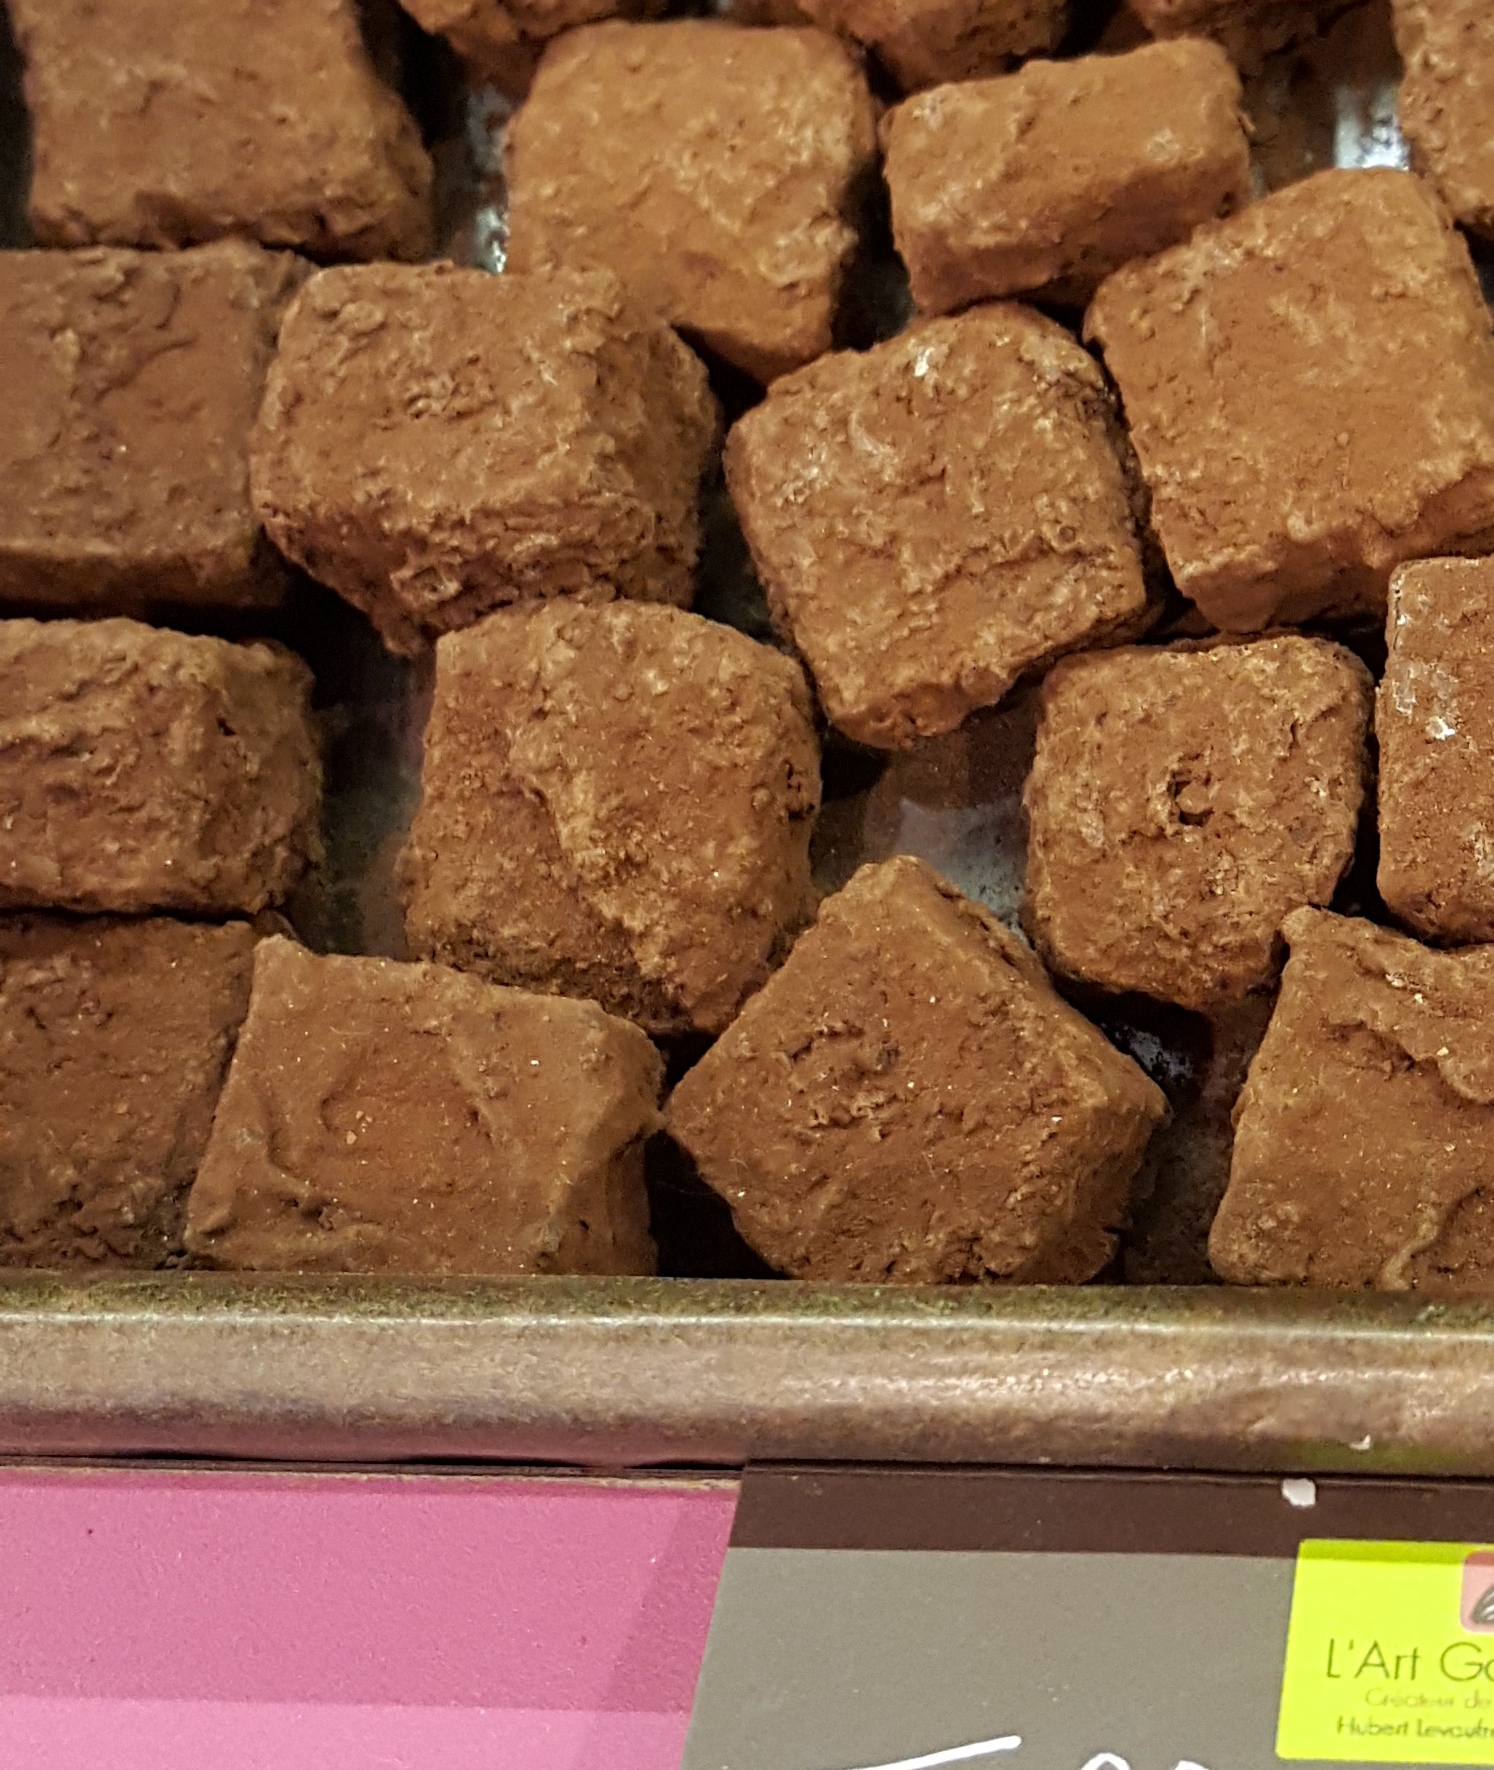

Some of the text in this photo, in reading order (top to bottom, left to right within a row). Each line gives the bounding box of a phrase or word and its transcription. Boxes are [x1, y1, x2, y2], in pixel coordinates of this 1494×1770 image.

[1325, 1637, 1420, 1681] L'Art
[1465, 1689, 1493, 1710] de
[1337, 1715, 1410, 1736] Hubert
